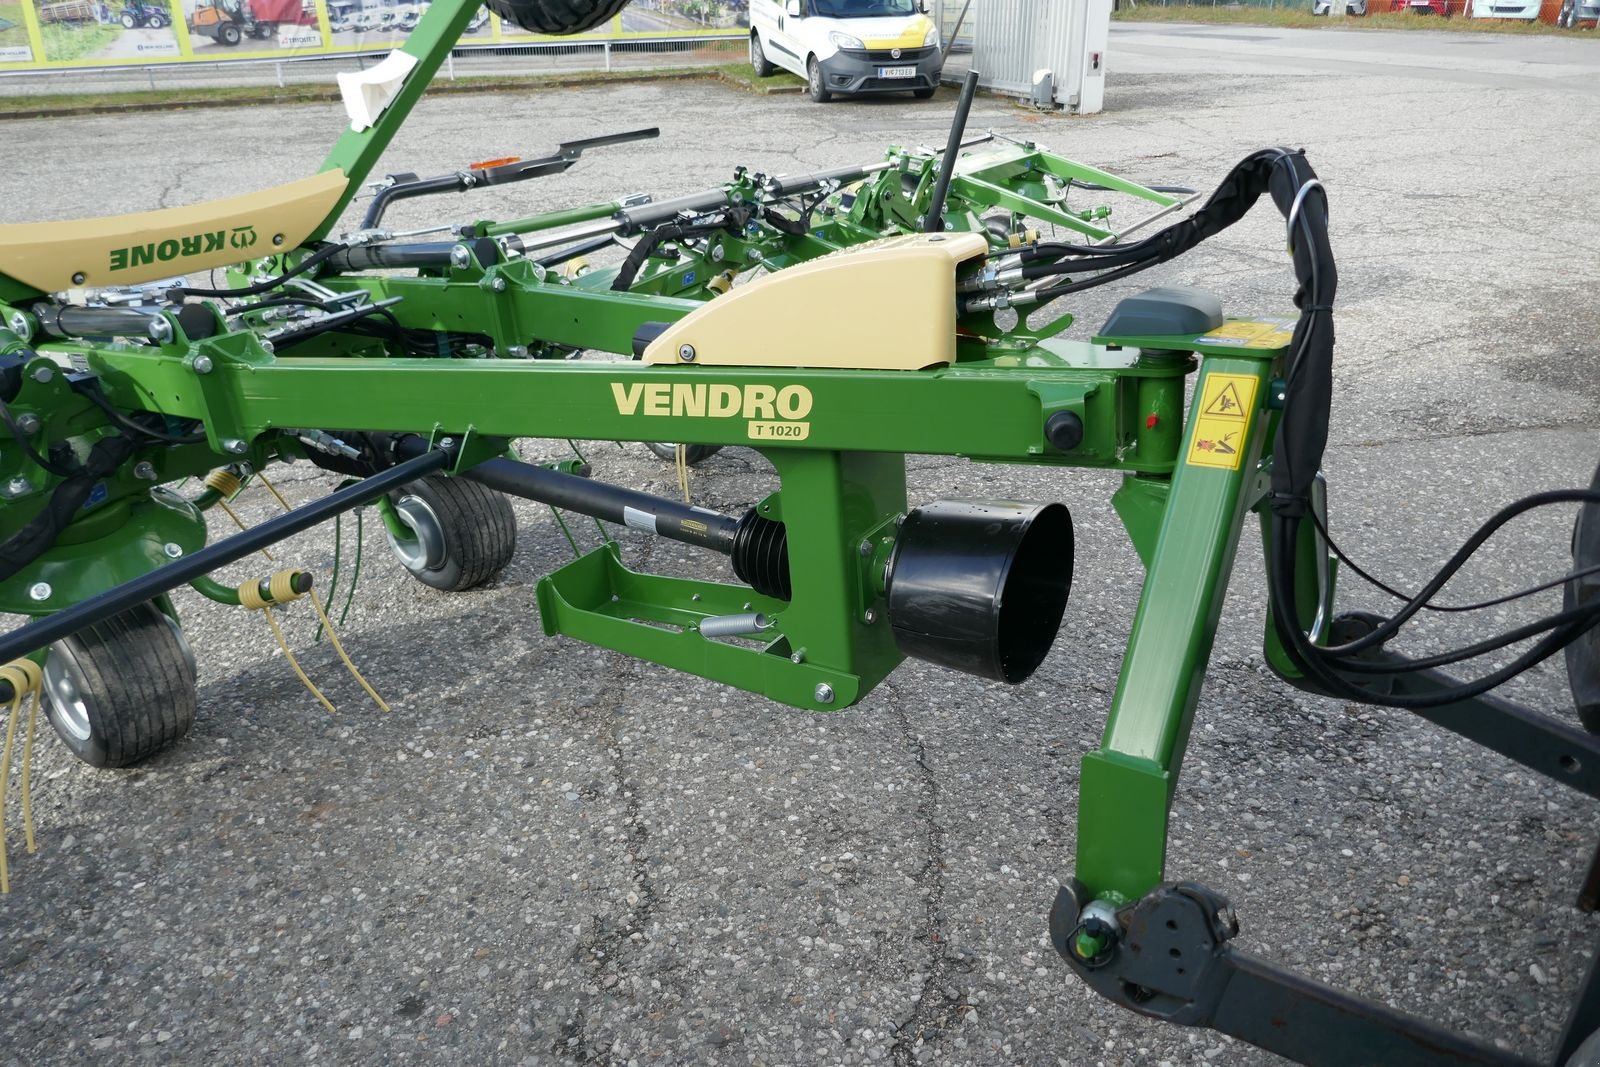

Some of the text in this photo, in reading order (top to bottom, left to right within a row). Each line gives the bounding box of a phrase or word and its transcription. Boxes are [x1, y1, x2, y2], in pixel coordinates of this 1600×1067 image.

[109, 230, 226, 271] KRONE
[610, 382, 813, 420] VENDRO
[756, 425, 801, 437] T 1020
